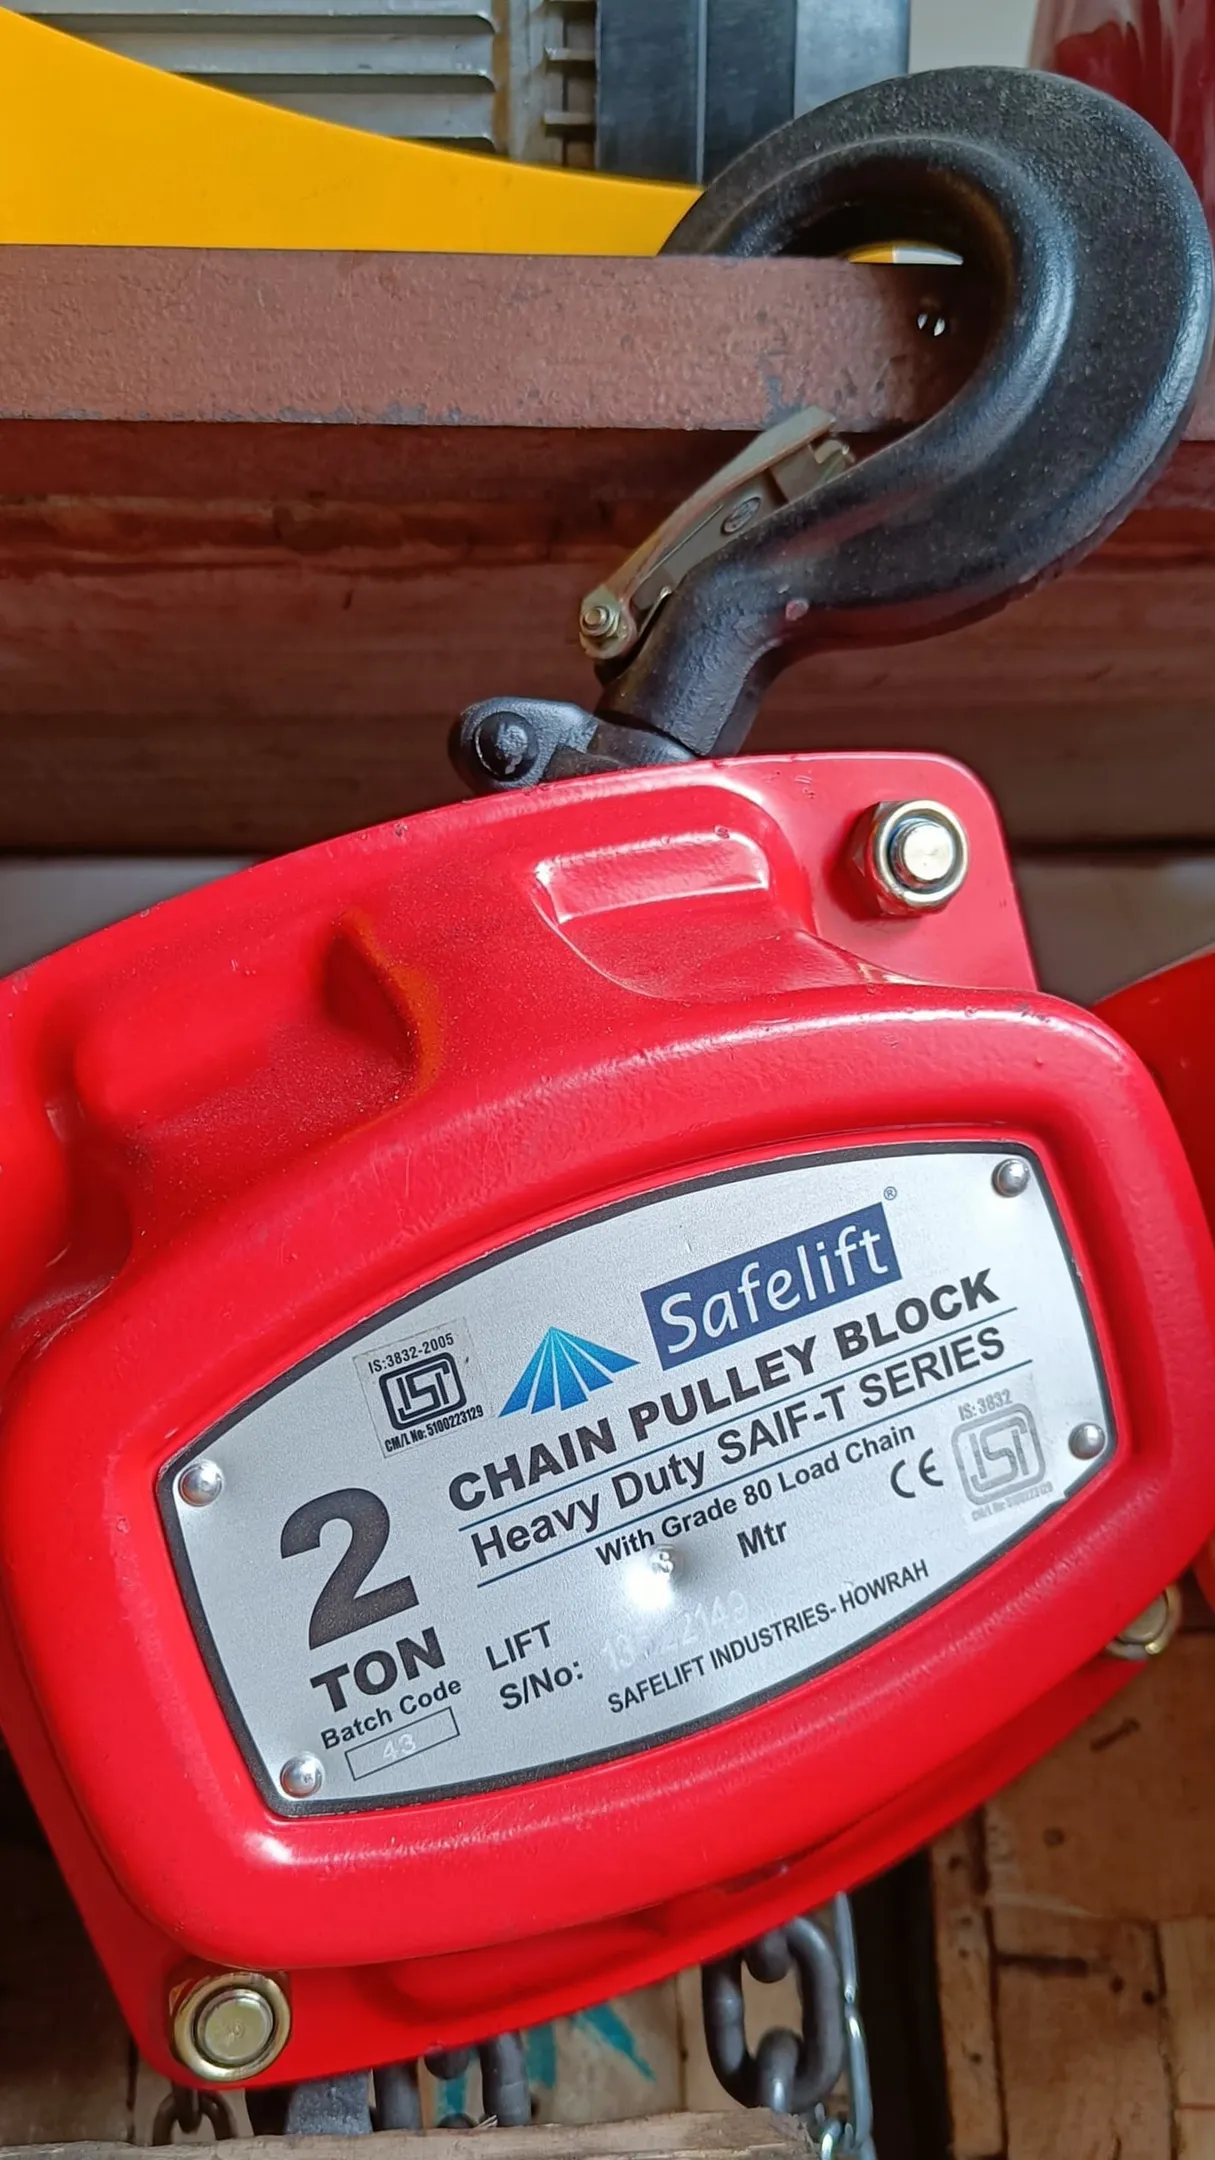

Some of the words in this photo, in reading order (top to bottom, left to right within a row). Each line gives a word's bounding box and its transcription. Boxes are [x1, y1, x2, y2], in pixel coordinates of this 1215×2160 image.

[660, 1225, 889, 1353] Safelift
[368, 1333, 454, 1374] IS:3832-2005
[449, 1418, 617, 1511] CHAIN
[628, 1335, 817, 1442] PULLEY
[833, 1268, 1000, 1361] BLOCK
[385, 1433, 410, 1452] CM/L
[428, 1405, 484, 1437] 5100223129
[471, 1493, 599, 1567] Heavy
[611, 1450, 705, 1509] Duty
[717, 1385, 846, 1466] SAIF-T
[858, 1326, 1005, 1408] SERIES
[890, 1447, 944, 1498] CE
[595, 1529, 655, 1566] With
[661, 1497, 738, 1538] Grade
[743, 1478, 773, 1506] 80
[777, 1450, 840, 1493] Load
[845, 1424, 916, 1465] Chain
[280, 1487, 420, 1650] 2
[485, 1620, 550, 1671] LIFT
[737, 1519, 788, 1558] Mtr
[310, 1626, 445, 1713] TON
[499, 1658, 584, 1710] S/No:
[607, 1655, 705, 1714] SAFELIFT
[839, 1559, 930, 1613] HOWRAH
[320, 1707, 393, 1749] Batch
[399, 1680, 462, 1715] Code
